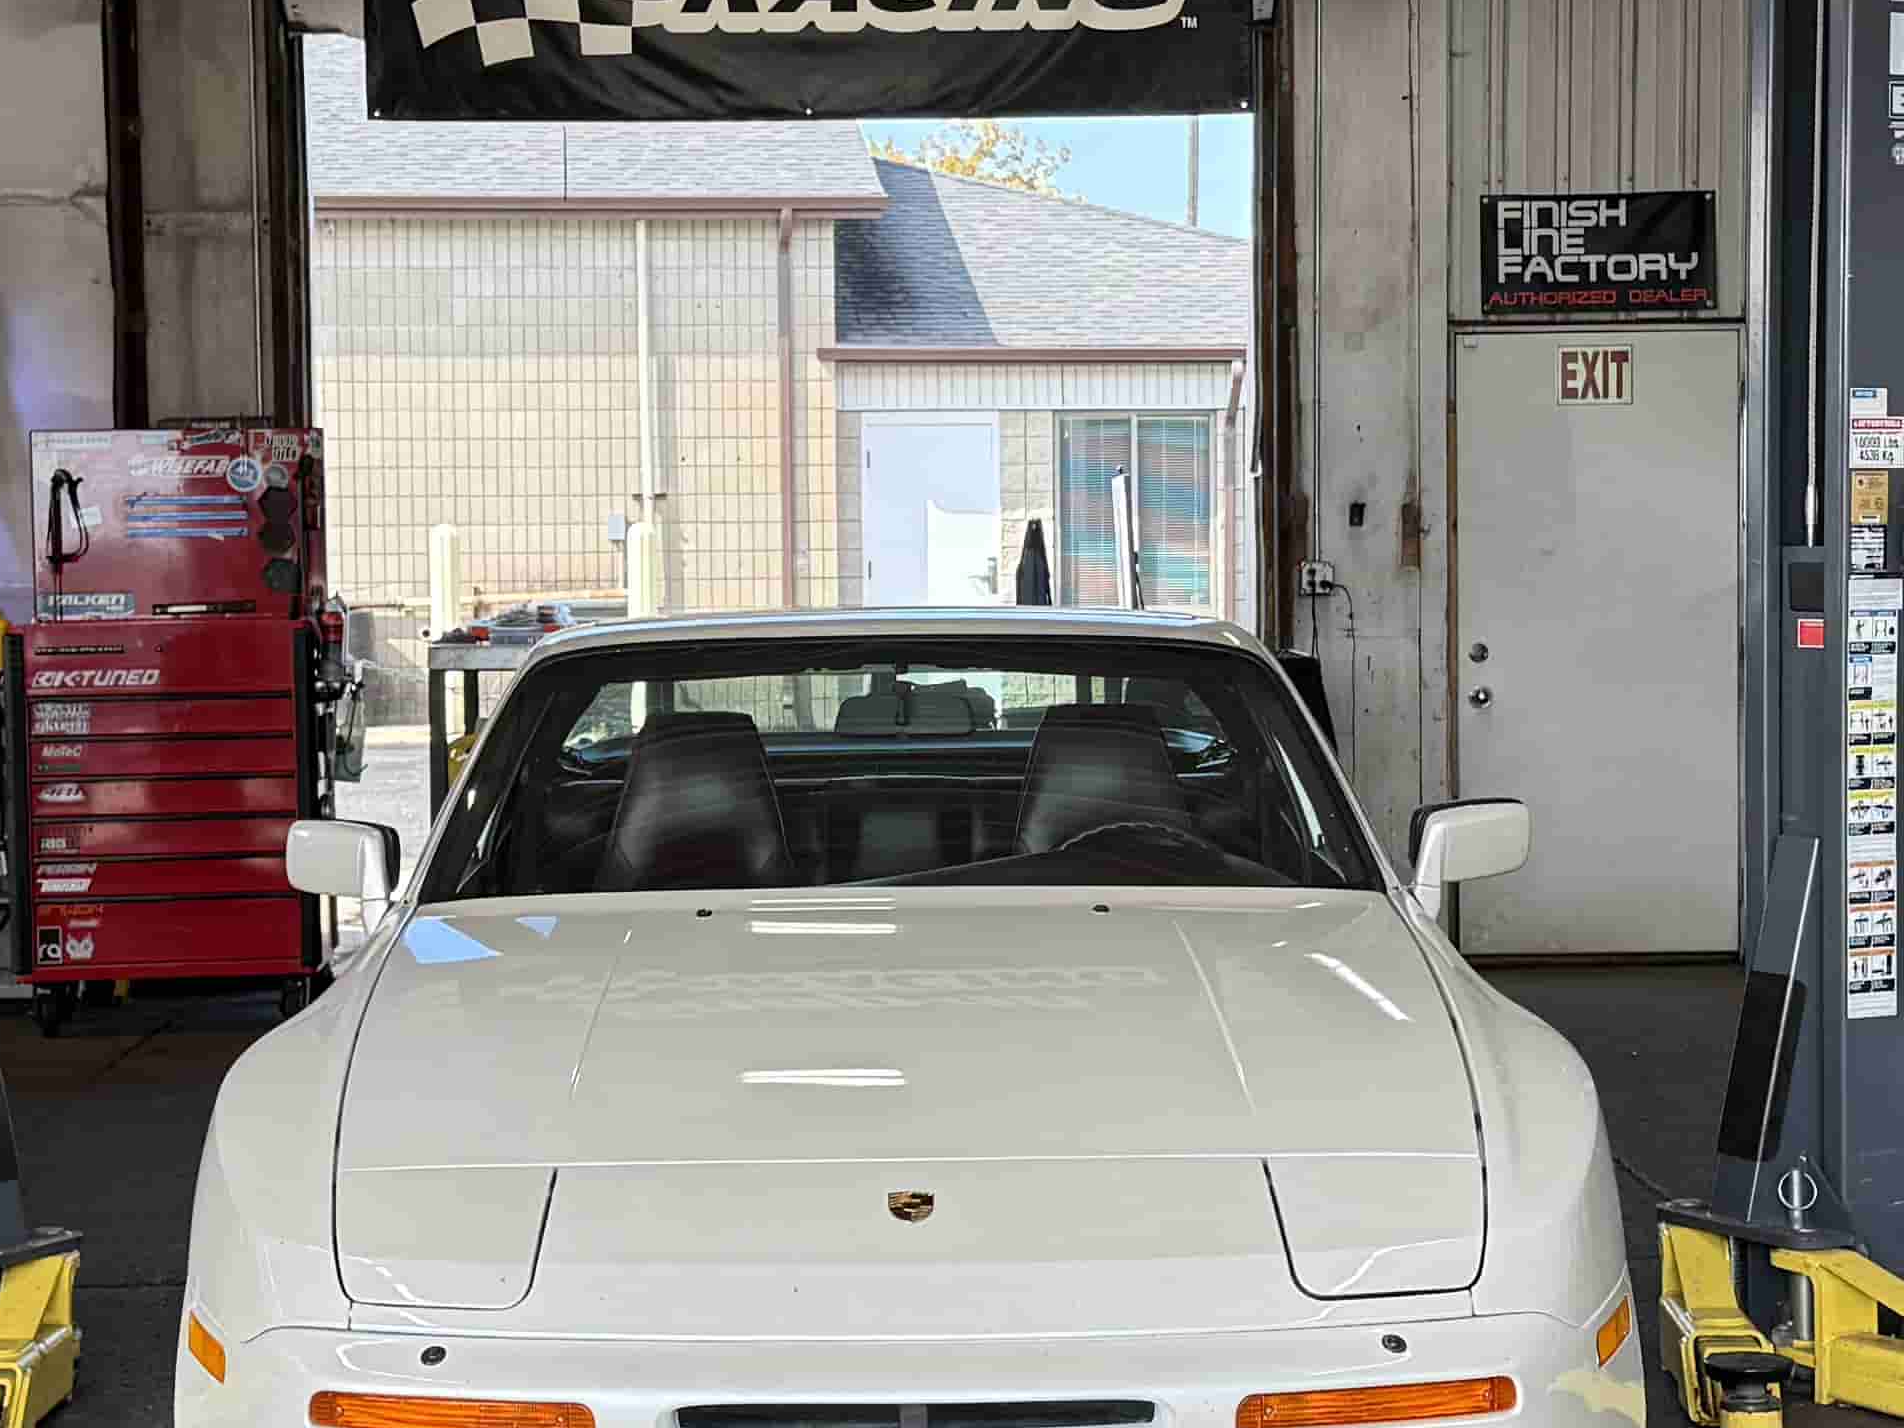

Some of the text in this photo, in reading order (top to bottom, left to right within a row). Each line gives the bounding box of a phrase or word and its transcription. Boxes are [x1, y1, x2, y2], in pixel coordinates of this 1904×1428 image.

[1497, 198, 1627, 229] FINISH
[1497, 227, 1586, 256] LINE
[1497, 251, 1699, 284] FACTORY
[1489, 288, 1709, 306] AUTHORIZED DEALER
[1560, 349, 1630, 400] EXIT
